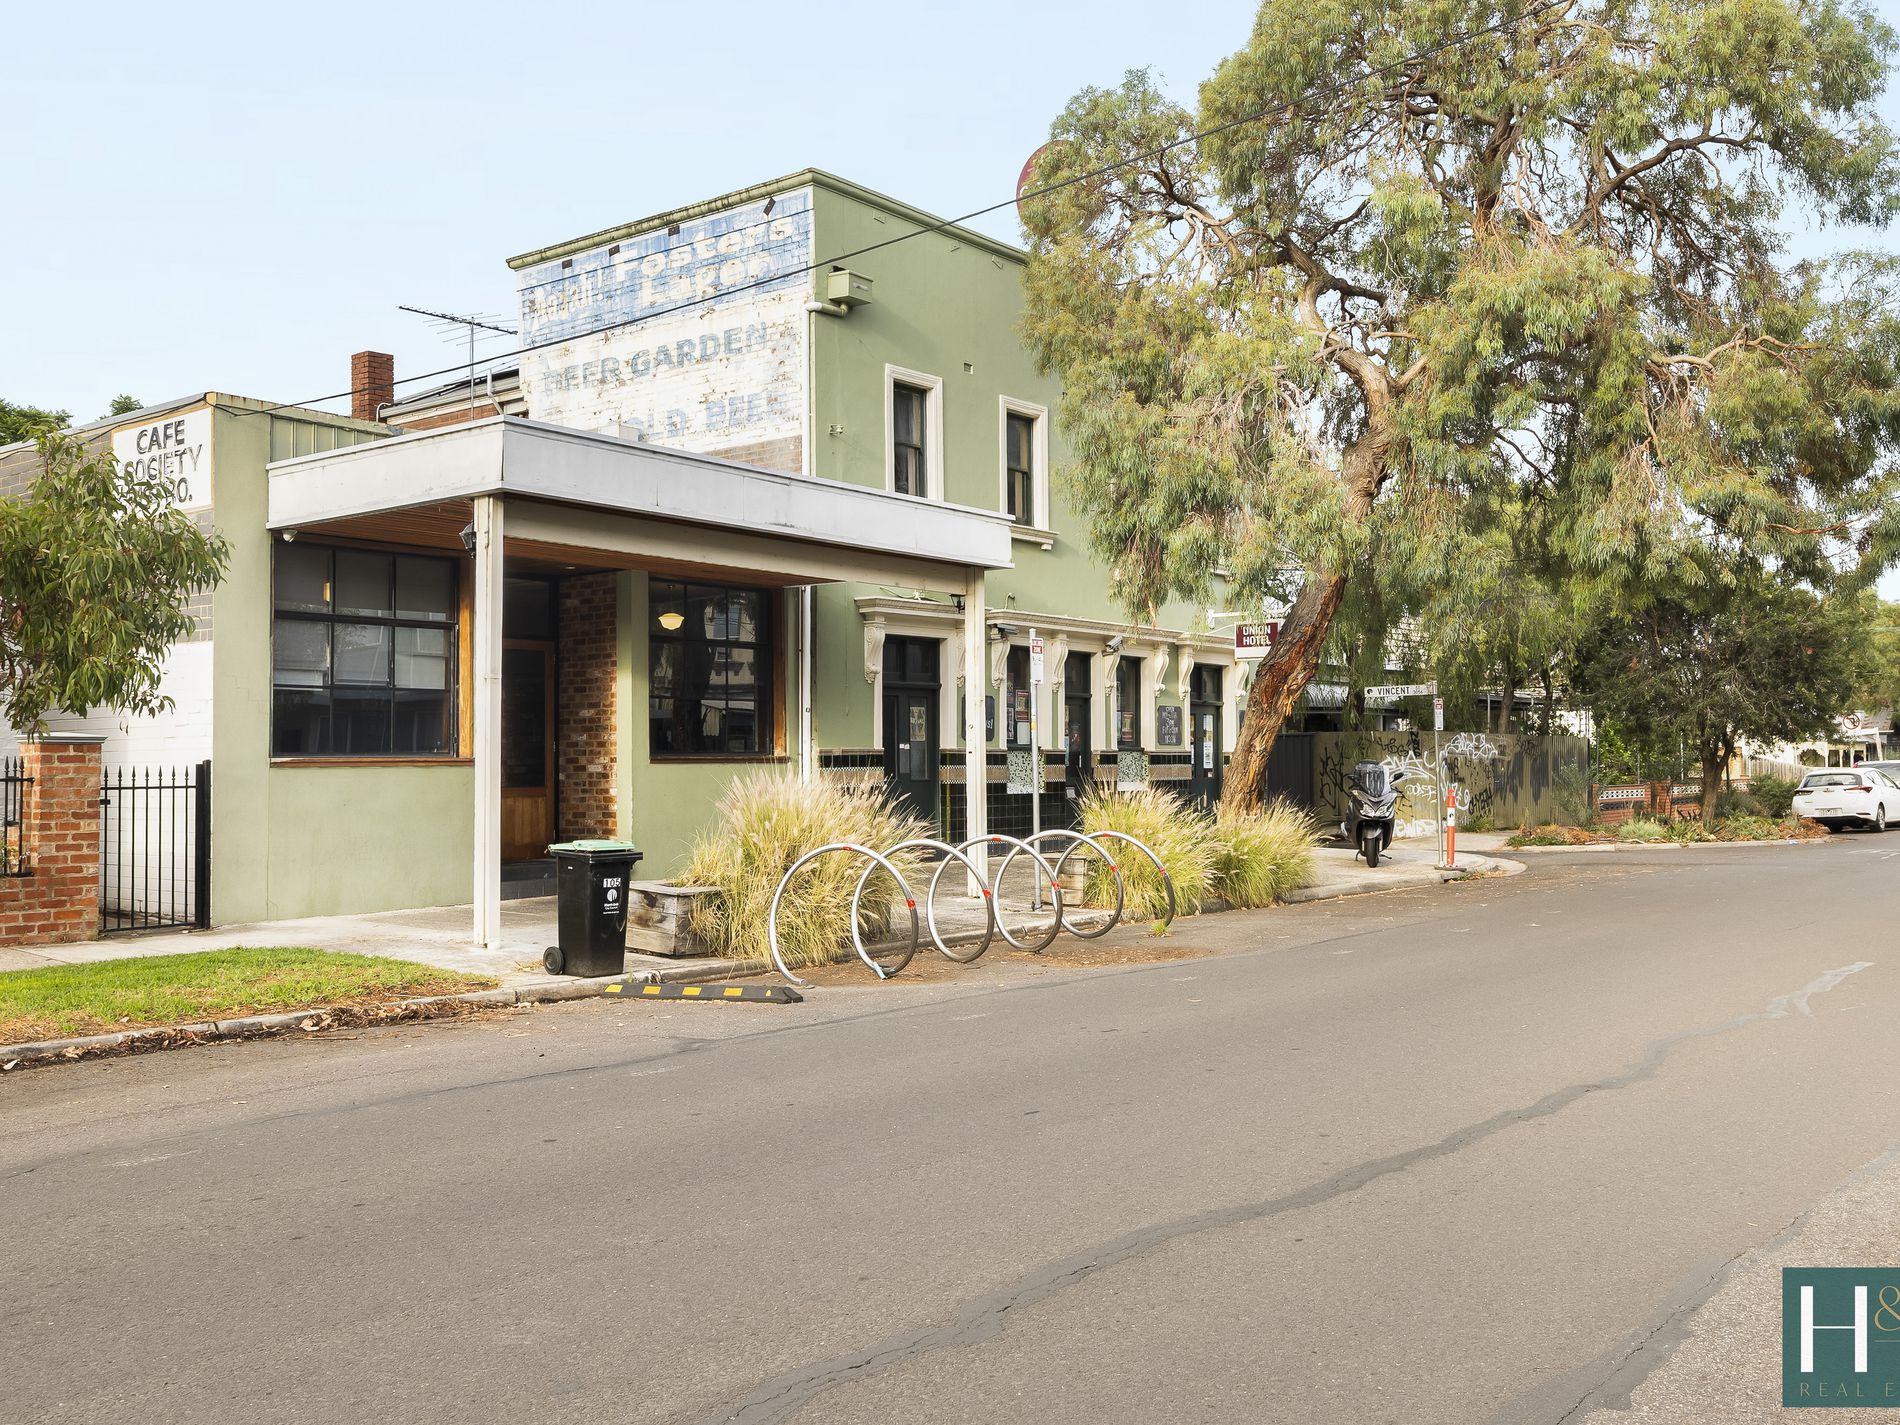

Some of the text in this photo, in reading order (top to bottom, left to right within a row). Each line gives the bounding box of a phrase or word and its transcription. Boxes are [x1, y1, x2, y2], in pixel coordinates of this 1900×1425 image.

[630, 321, 768, 378] GARDEN
[136, 419, 185, 455] CAFE
[124, 444, 203, 482] SOCIETY
[1242, 624, 1271, 636] UNION
[1243, 635, 1272, 646] HOTEL
[1377, 686, 1410, 695] VINCENT
